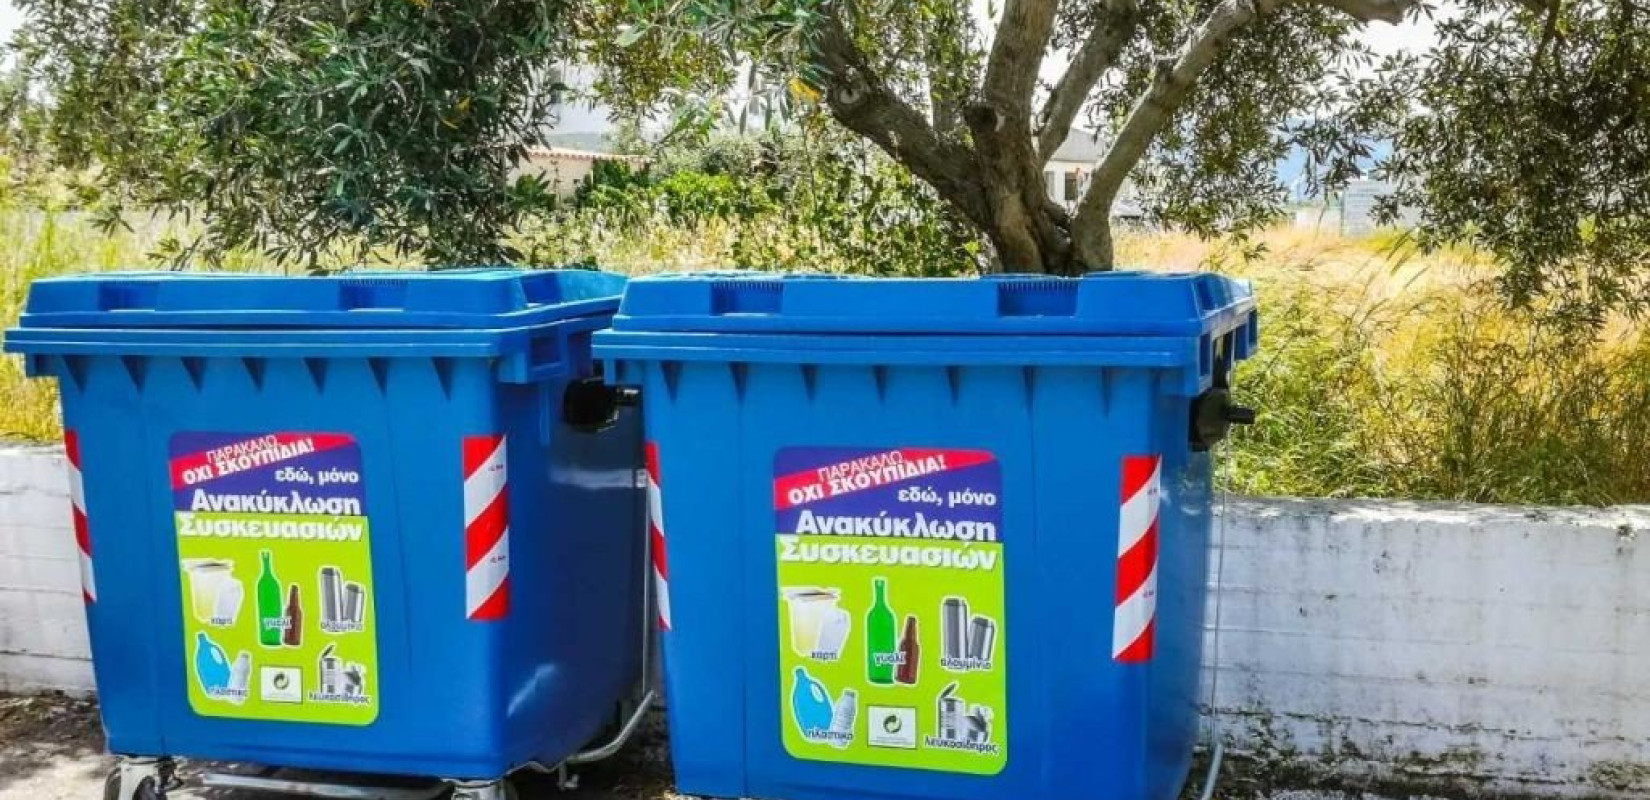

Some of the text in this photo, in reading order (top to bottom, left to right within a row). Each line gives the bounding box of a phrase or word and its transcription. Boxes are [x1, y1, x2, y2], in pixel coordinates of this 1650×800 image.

[182, 438, 315, 485] ΟΧΙ ΣΚΟΥΠΙΔΙΑ!
[206, 434, 278, 464] ΠΑΡΑΚΑΛΩ
[275, 466, 359, 486] εδώ, μόνο
[788, 454, 947, 505] ΟΧΙ ΣΚΟΥΠΙΔΙΑ!
[817, 450, 904, 482] ΠΑΡΑΚΑΛΩ
[192, 488, 361, 515] Ανακύκλωση
[898, 486, 996, 508] εδώ, μόνο
[180, 512, 362, 541] Συσκευασιών
[796, 510, 996, 541] Ανακύκλωση
[779, 535, 997, 570] Συσκευασιών
